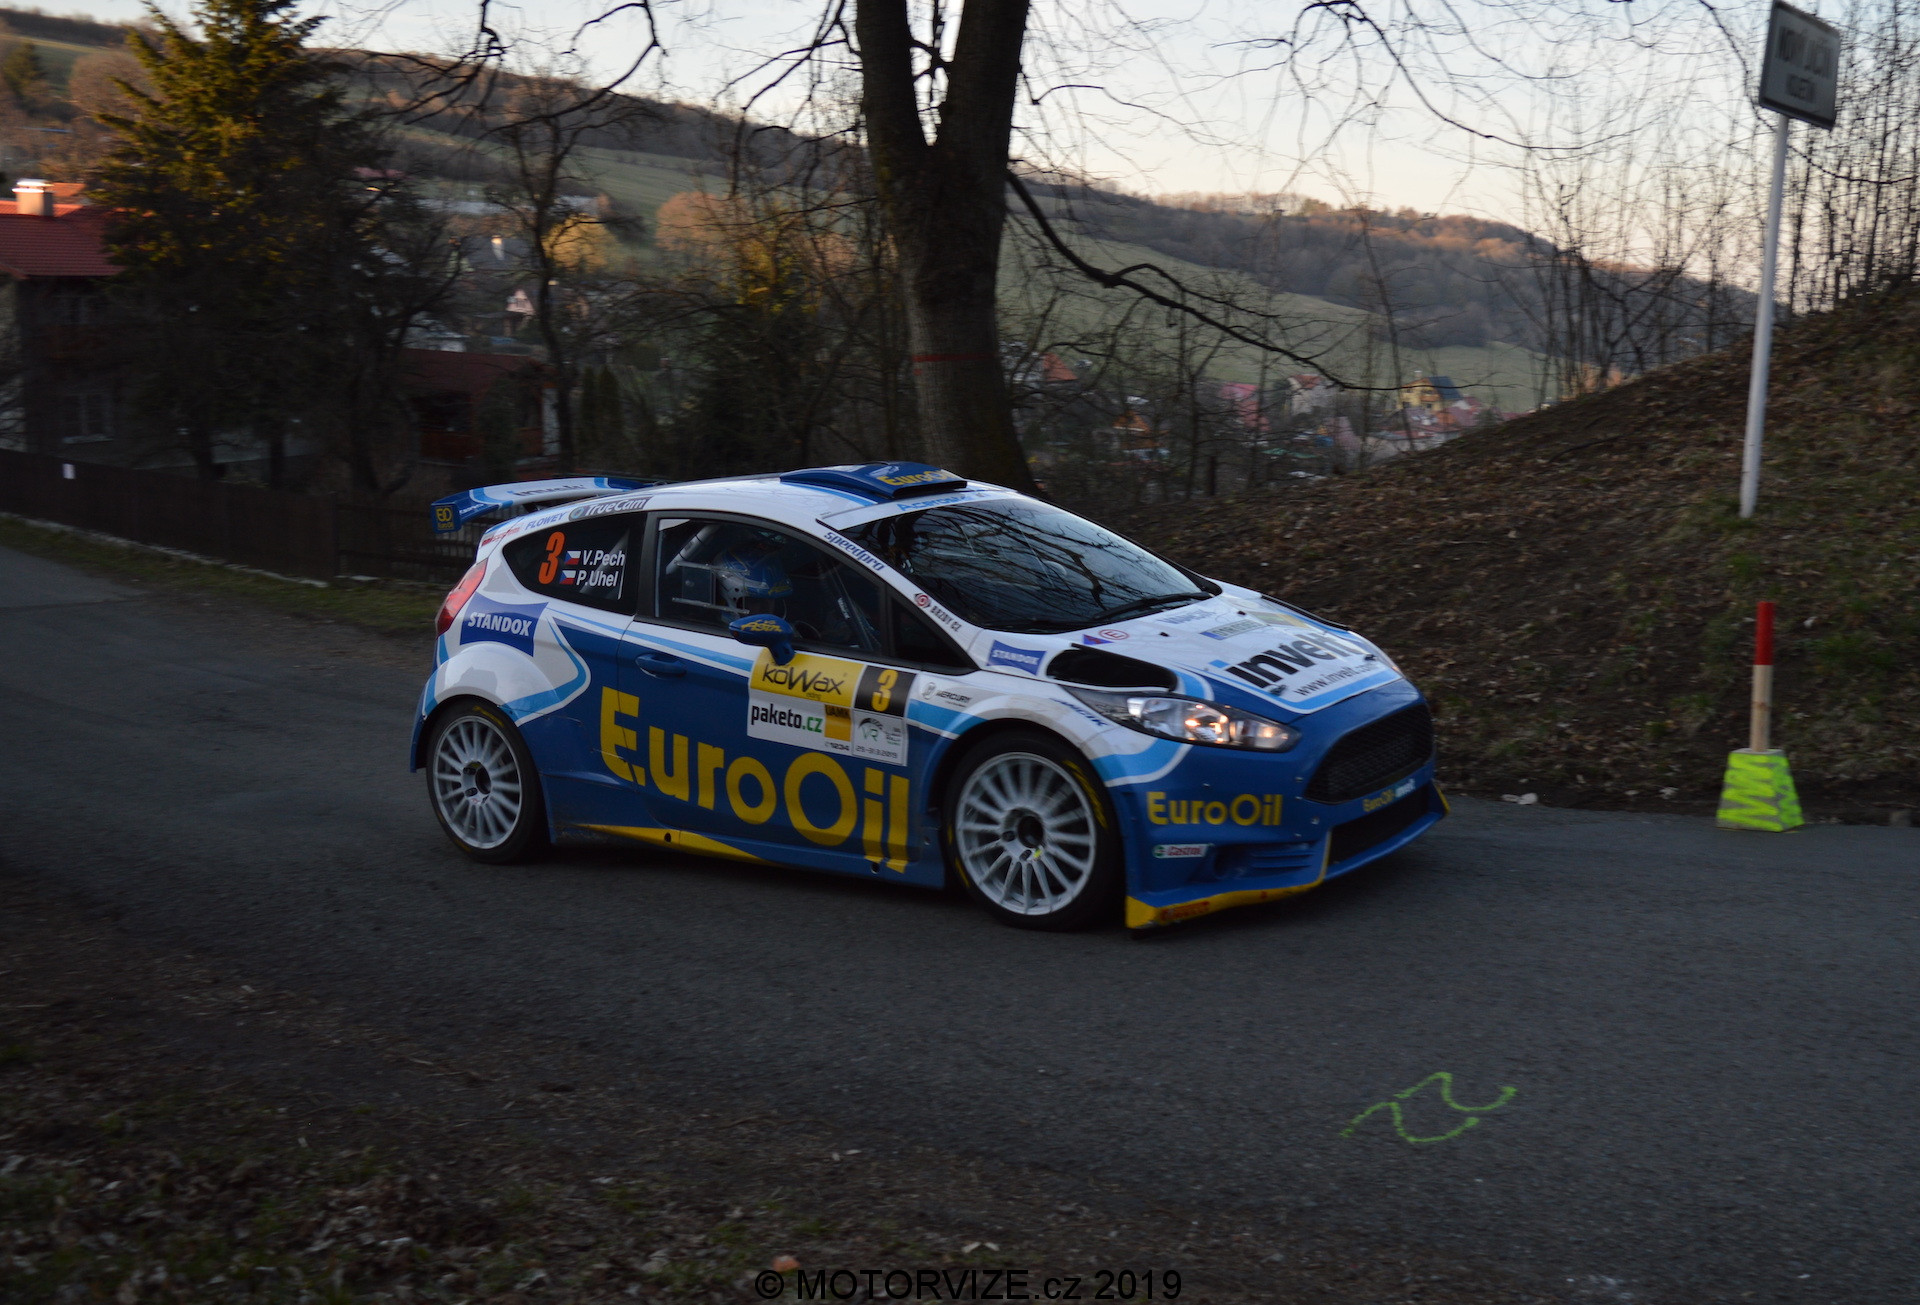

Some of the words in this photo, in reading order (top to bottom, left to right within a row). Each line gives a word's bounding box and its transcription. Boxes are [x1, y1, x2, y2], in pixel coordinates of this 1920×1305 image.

[525, 512, 567, 530] FLOWEY
[584, 498, 646, 517] TrueCam
[538, 531, 566, 585] 3
[582, 550, 626, 567] V.Pech
[823, 531, 887, 571] speedpro
[576, 570, 619, 587] P.Uhel
[468, 611, 532, 637] STANDOX
[991, 648, 1040, 666] STANDOX
[1209, 633, 1362, 689] invelt
[871, 669, 899, 712] 3
[751, 703, 823, 733] paketo.cz
[600, 686, 909, 874] EuroOil
[1146, 791, 1283, 826] EuroOil
